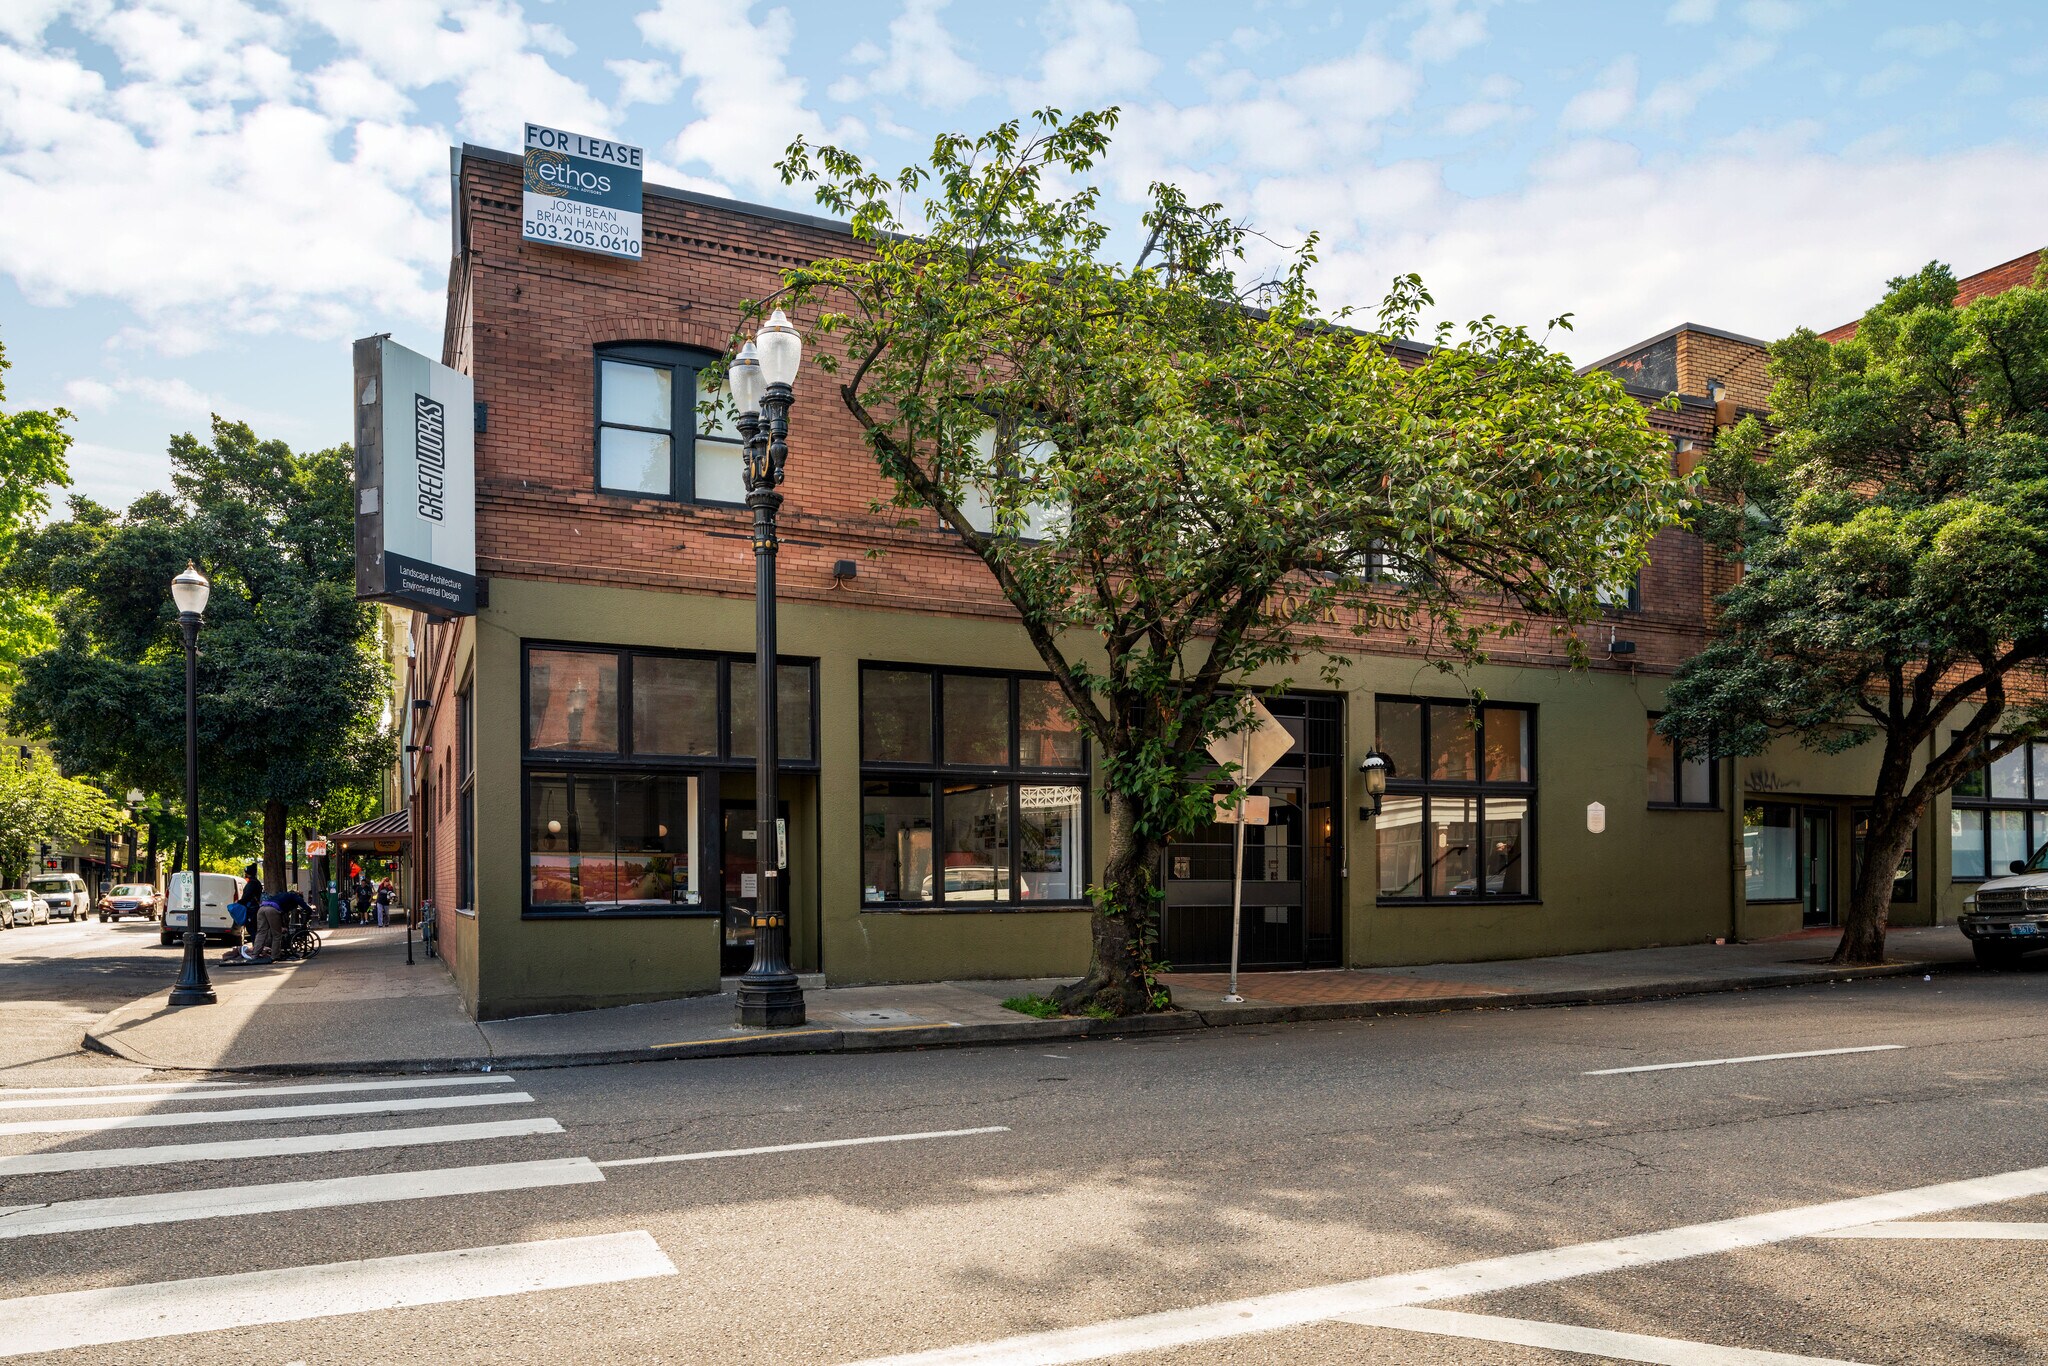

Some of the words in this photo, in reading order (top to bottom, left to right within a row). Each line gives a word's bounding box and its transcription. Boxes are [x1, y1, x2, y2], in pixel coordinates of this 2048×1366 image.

[527, 125, 569, 151] FOR
[578, 136, 640, 167] LEASE
[539, 163, 611, 192] ethos
[550, 181, 579, 191] COMMERCIAL
[537, 210, 573, 226] BRIAN
[577, 217, 629, 237] HANSON
[550, 200, 582, 215] JOSH
[585, 206, 617, 222] BEAN
[525, 220, 640, 254] 503.205.0610
[399, 564, 429, 582] Landscape
[429, 573, 462, 590] Architecture
[441, 588, 460, 603] Design
